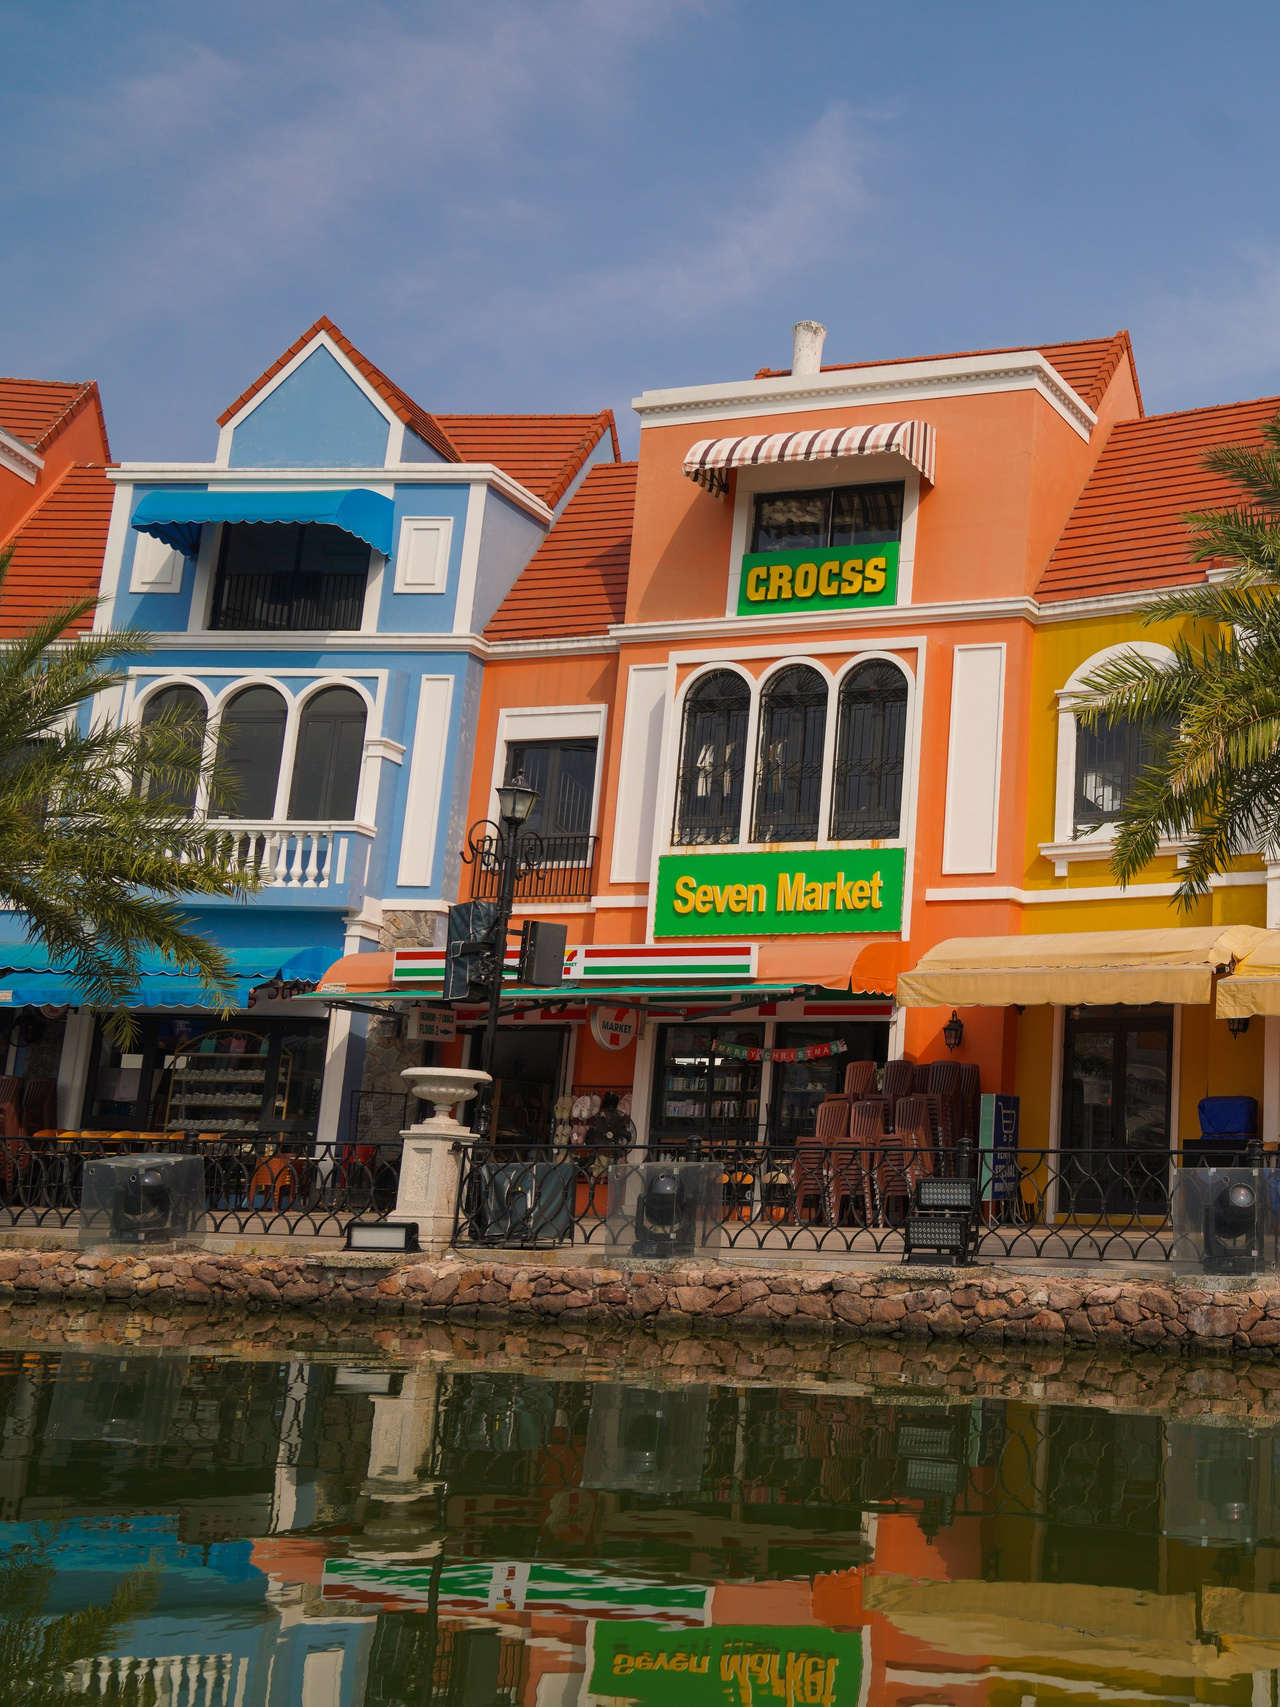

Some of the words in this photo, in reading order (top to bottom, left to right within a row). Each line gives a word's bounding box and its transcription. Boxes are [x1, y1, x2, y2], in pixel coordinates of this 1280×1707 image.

[746, 556, 887, 602] CROCSS
[673, 875, 767, 914] Seven
[776, 870, 884, 912] Market
[419, 1023, 435, 1035] FLOOR
[435, 1024, 439, 1036] 2
[601, 1020, 632, 1035] MARKET
[718, 1044, 756, 1058] MERRY
[765, 1044, 837, 1059] CHRISTMAS
